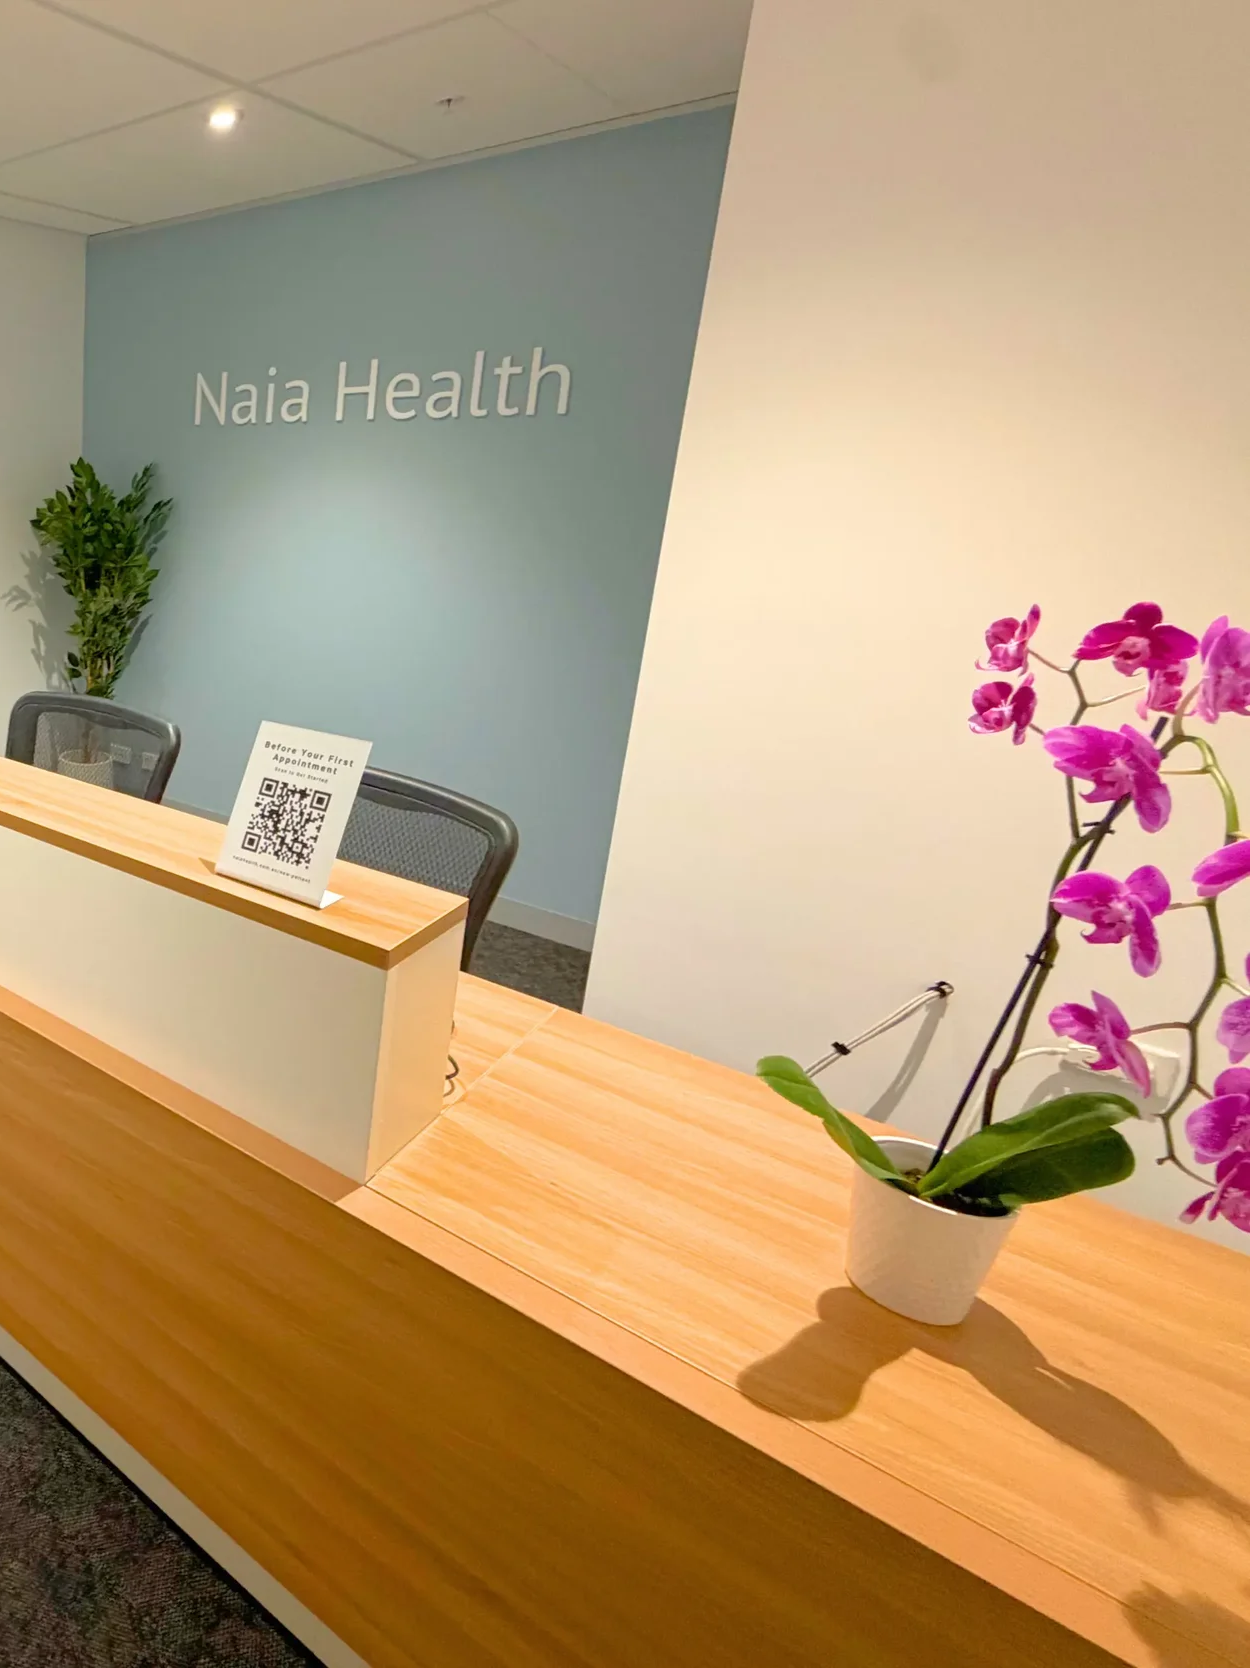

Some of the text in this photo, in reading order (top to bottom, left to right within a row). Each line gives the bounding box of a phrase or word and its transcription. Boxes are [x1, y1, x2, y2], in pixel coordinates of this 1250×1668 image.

[193, 346, 572, 426] Naia Health
[264, 740, 354, 768] Before Your First
[272, 753, 338, 775] Appointment
